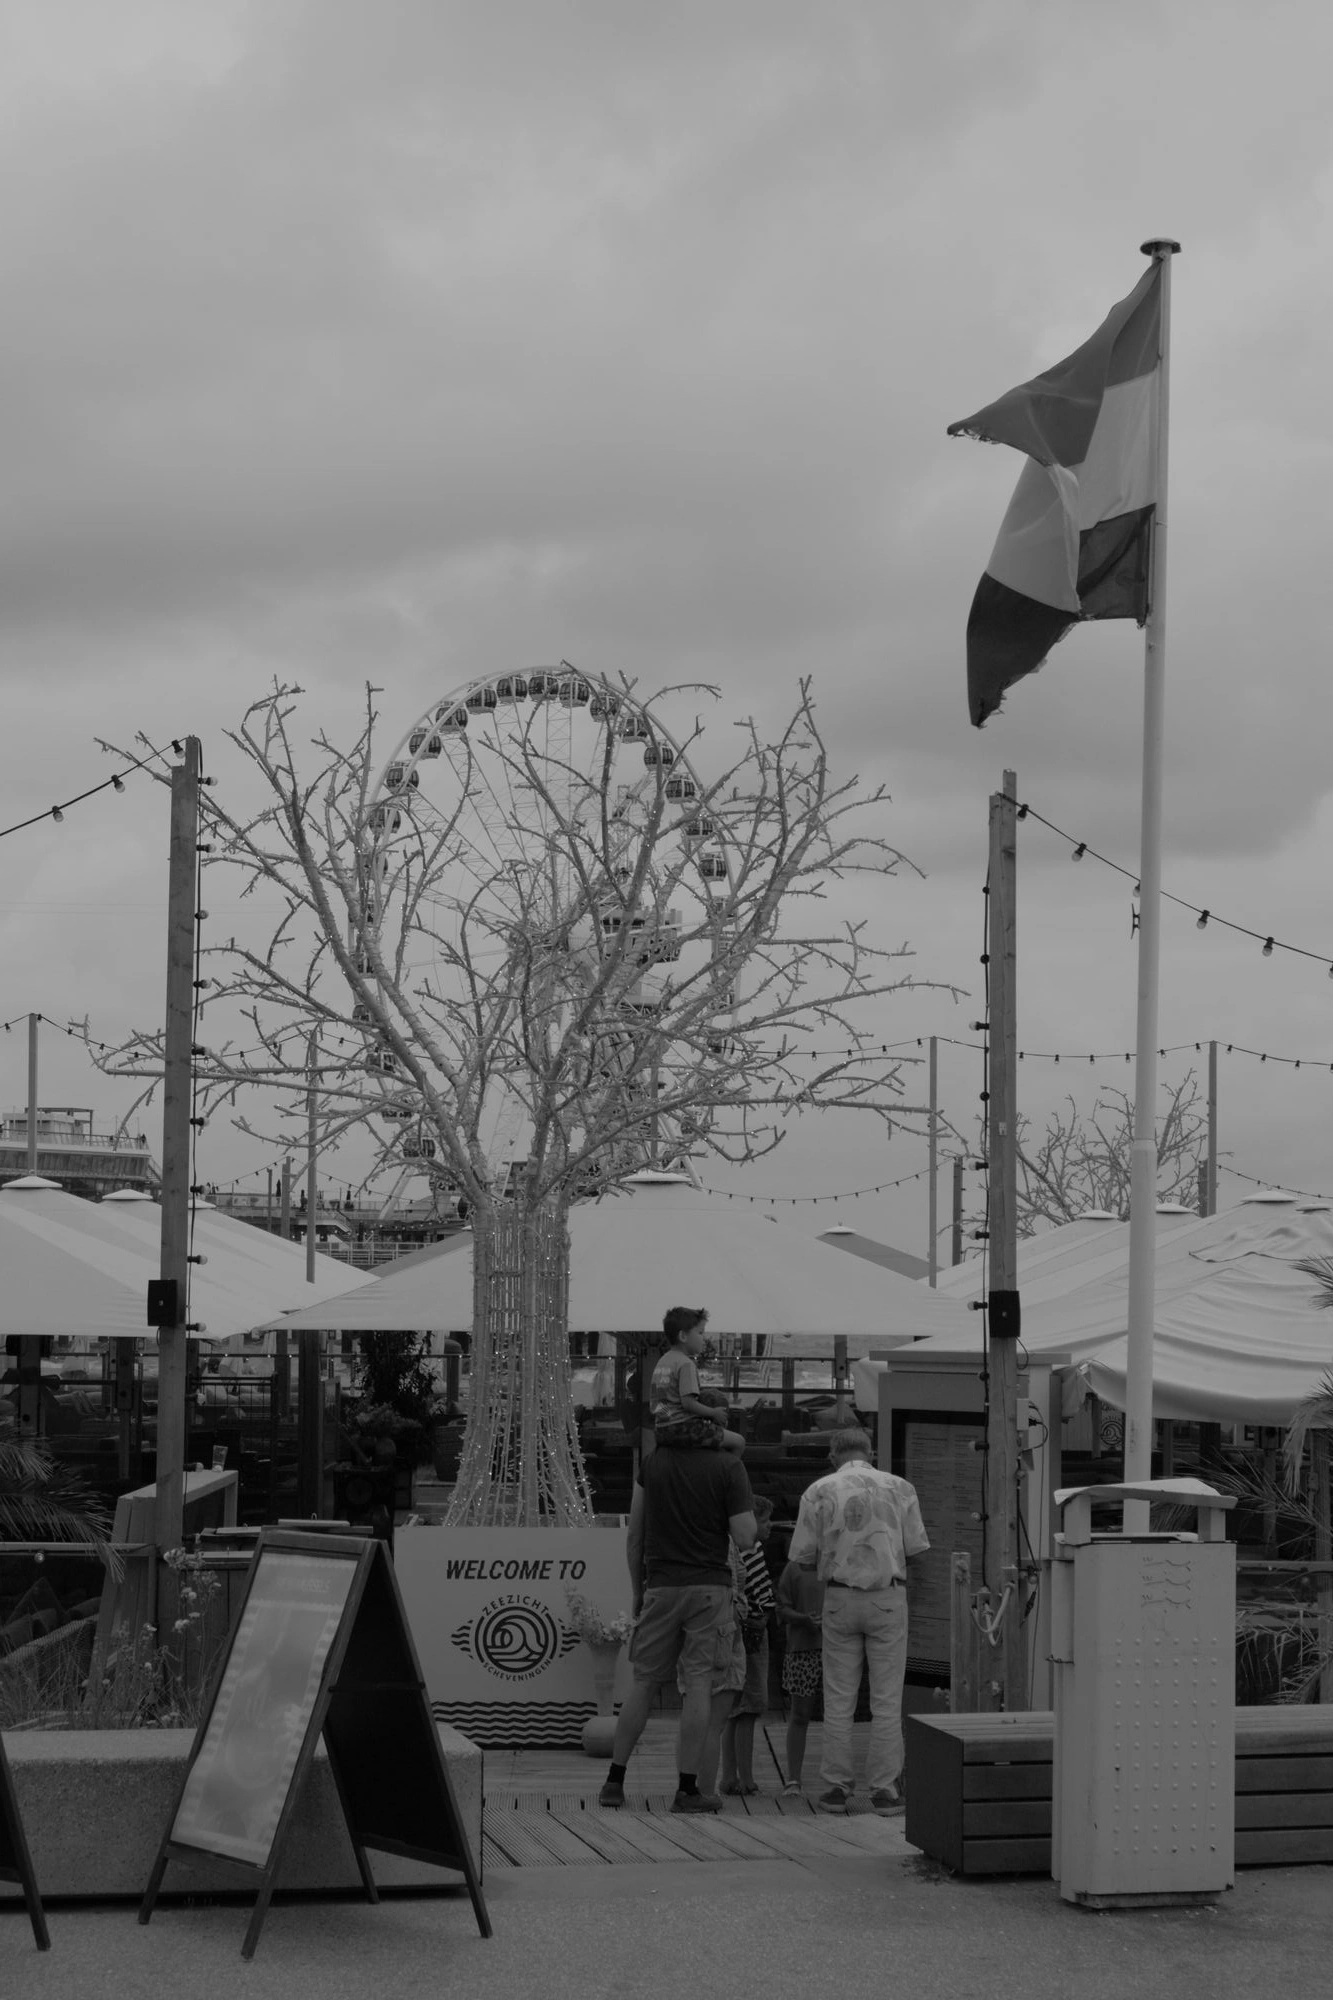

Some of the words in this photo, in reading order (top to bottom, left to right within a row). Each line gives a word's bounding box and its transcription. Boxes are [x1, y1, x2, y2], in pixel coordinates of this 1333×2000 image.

[446, 1559, 554, 1580] WELCOME
[558, 1559, 587, 1581] TO
[482, 1594, 550, 1616] ZEEZICHT
[482, 1657, 552, 1682] SCHEVENINGEN
